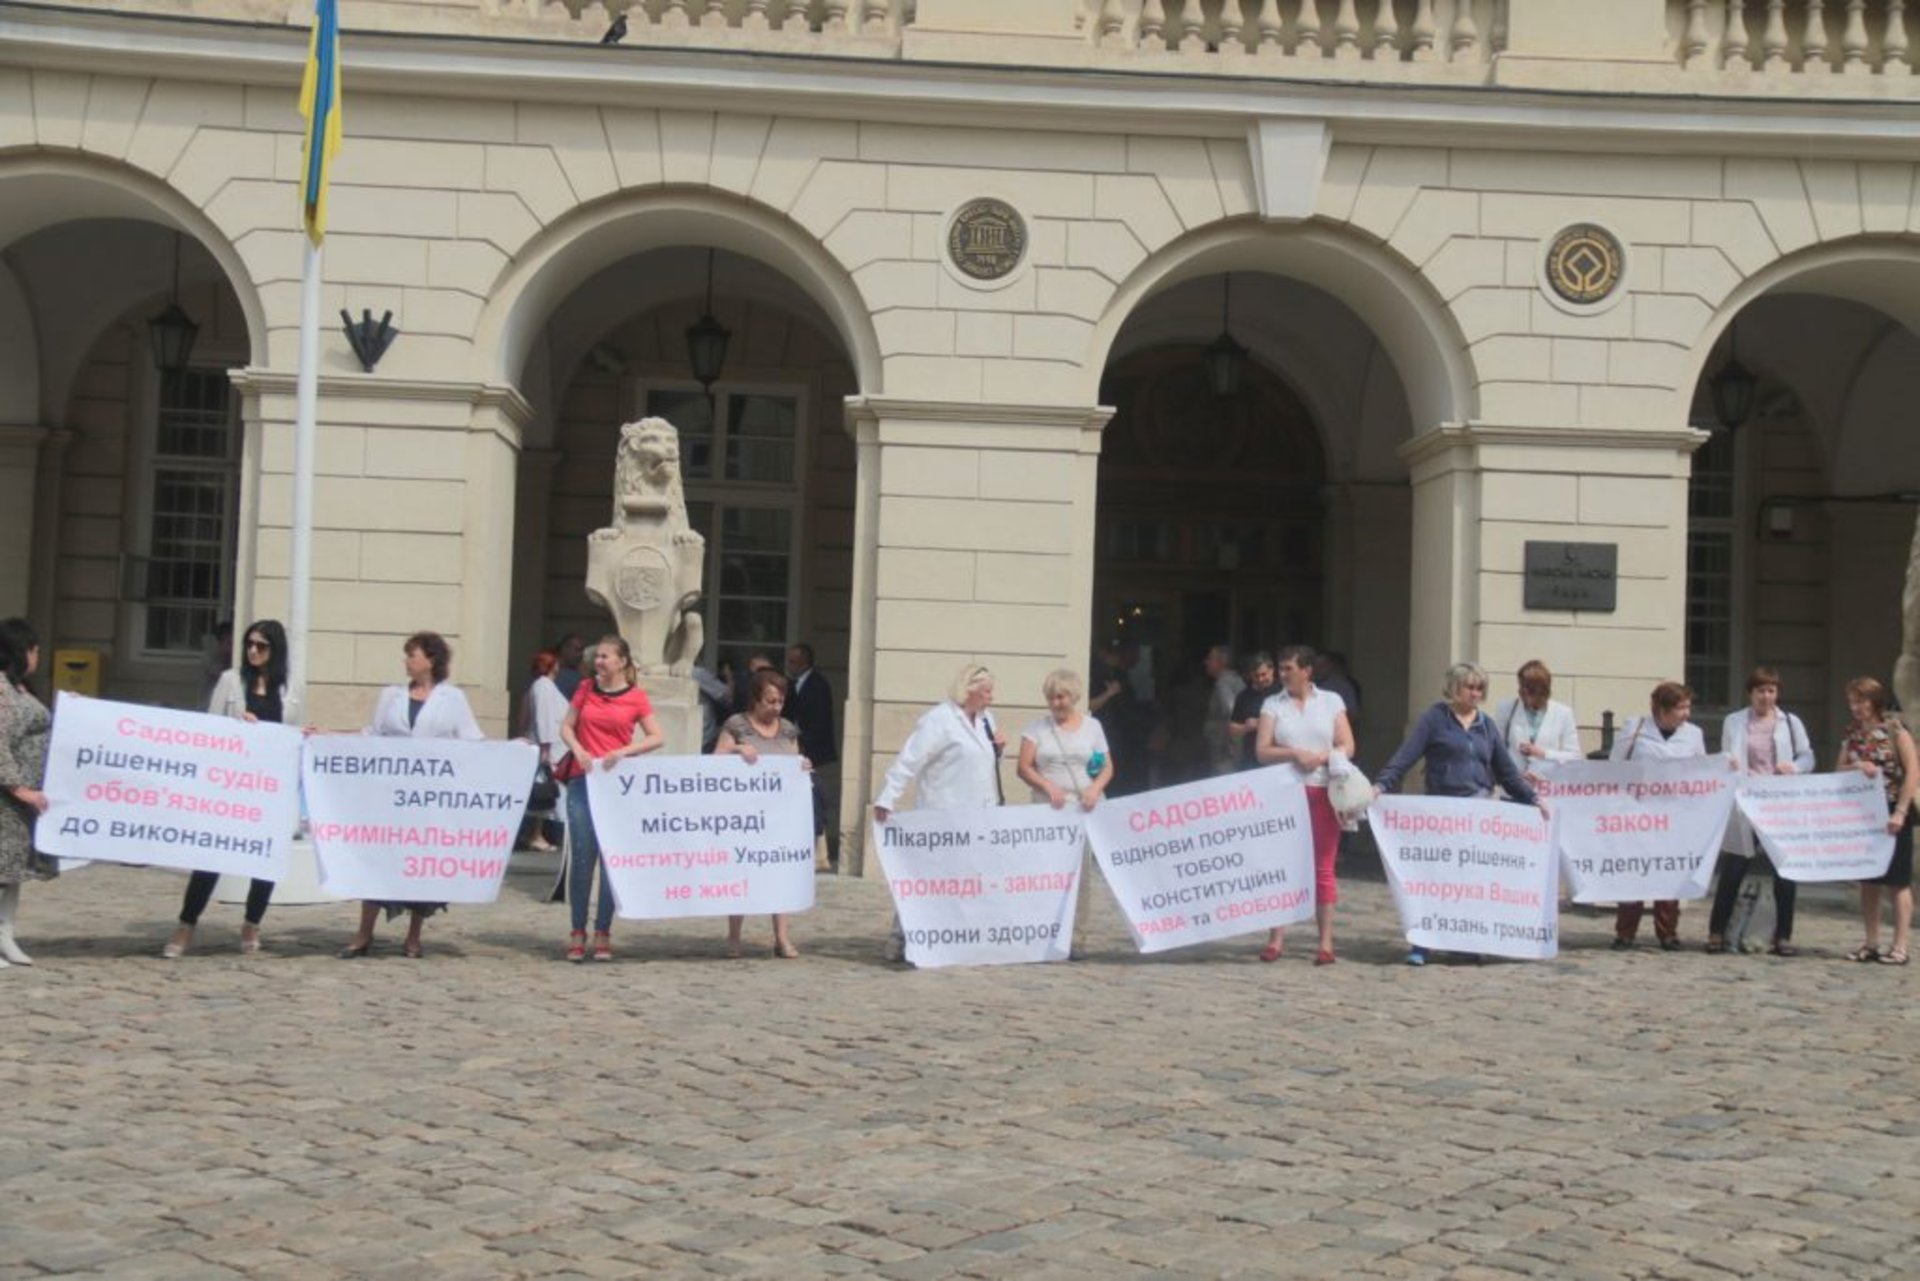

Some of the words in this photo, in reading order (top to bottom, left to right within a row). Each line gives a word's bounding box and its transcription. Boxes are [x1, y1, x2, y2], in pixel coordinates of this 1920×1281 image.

[117, 717, 251, 756] Садовий,
[76, 744, 197, 778] рішення
[206, 765, 280, 793] судів
[313, 755, 455, 777] НЕВИПЛАТА
[618, 774, 635, 796] У
[643, 771, 783, 795] Львівській
[1536, 780, 1618, 797] Вимоги
[85, 779, 263, 822] обов'язкове
[1129, 785, 1264, 832] САДОВИЙ,
[642, 810, 765, 835] міськраді
[1383, 809, 1473, 835] Народні
[1594, 814, 1670, 833] закон
[60, 816, 99, 837] до
[110, 820, 273, 857] виконання!
[312, 823, 509, 848] КРИМІНАЛЬНИЙ
[883, 826, 971, 851] Лікарям
[1110, 837, 1194, 867] ВІДНОВИ
[1199, 815, 1297, 849] ПОРУШЕНІ
[605, 849, 729, 869] онституція
[734, 846, 812, 867] України
[1173, 852, 1244, 879] ТОБОЮ
[1399, 846, 1452, 862] ваше
[1458, 845, 1526, 870] рішення
[665, 883, 692, 900] не
[1141, 868, 1287, 912] КОНСТИТУЦІЙНІ
[1138, 915, 1187, 935] РАВА
[1192, 913, 1210, 926] та
[907, 928, 980, 949] хорони
